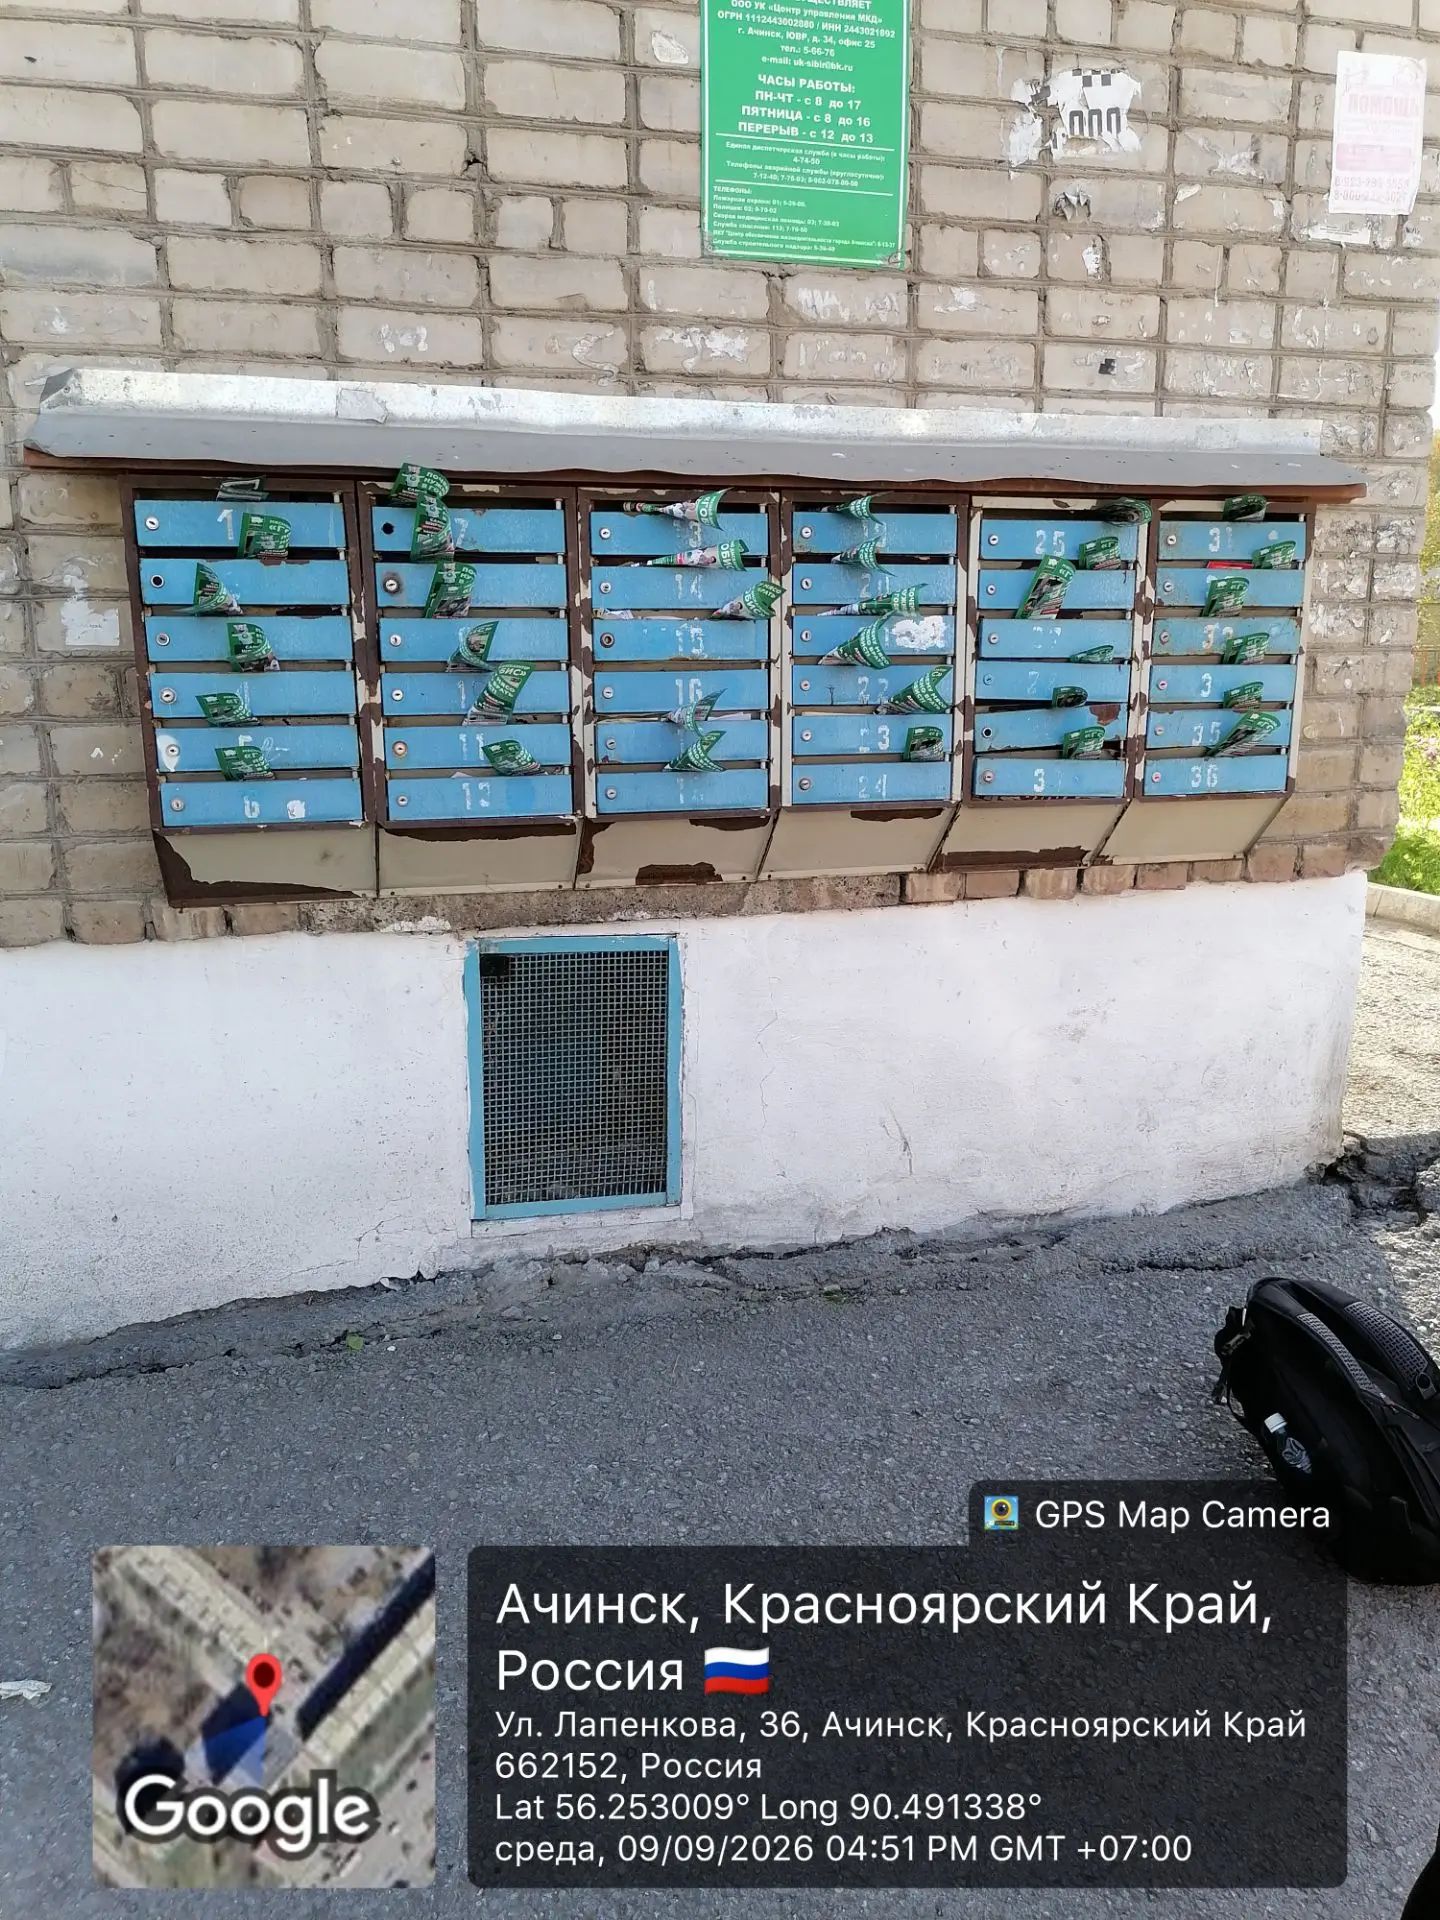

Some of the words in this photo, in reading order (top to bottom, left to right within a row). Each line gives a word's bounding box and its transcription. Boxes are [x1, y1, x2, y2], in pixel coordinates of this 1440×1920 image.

[731, 0, 752, 9] ООО
[754, 2, 767, 10] УК
[717, 10, 743, 21] ОГРН
[821, 22, 842, 32] ИНН
[864, 39, 876, 49] 25
[758, 74, 796, 87] ЧАСЫ
[799, 78, 856, 93] РАБОТЫ:
[755, 90, 794, 103] ПН-ЧТ
[815, 96, 822, 106] 8
[828, 99, 844, 110] до
[848, 100, 862, 110] 17
[741, 105, 803, 122] ПЯТНИЦА
[824, 113, 832, 123] 8
[838, 117, 853, 127] до
[857, 116, 871, 127] 16
[738, 122, 799, 136] ПЕРЕРЫВ
[821, 129, 835, 140] 12
[841, 133, 856, 143] до
[859, 133, 874, 143] 13
[217, 509, 234, 540] 1
[1035, 529, 1066, 557] 25
[1190, 764, 1218, 789] 36
